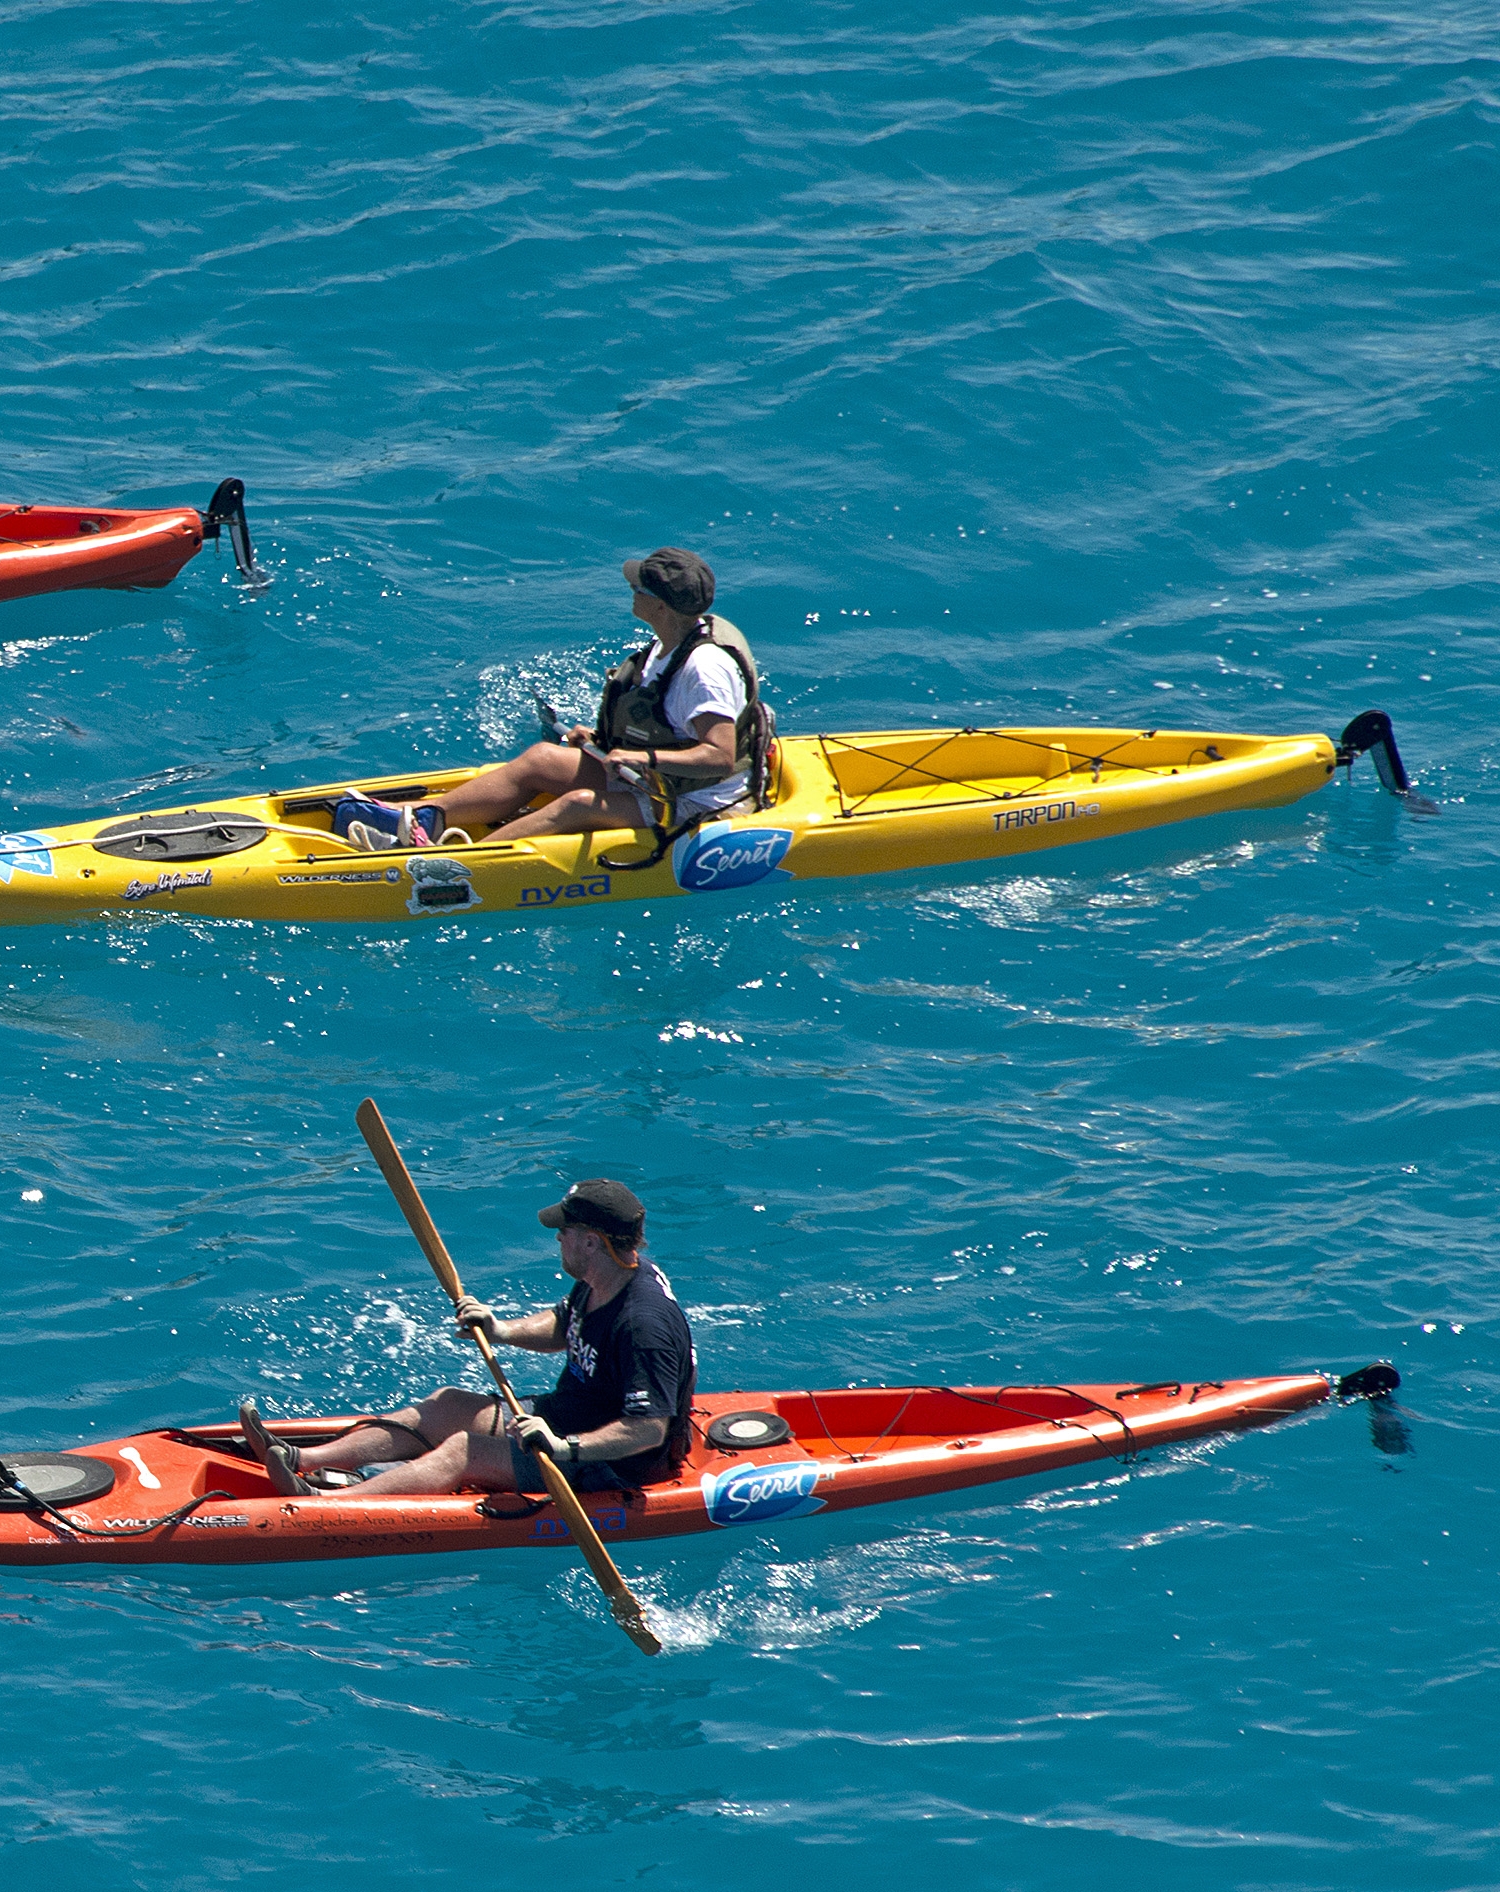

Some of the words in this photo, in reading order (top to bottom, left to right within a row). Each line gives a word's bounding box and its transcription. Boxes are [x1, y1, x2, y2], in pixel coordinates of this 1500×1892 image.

[993, 801, 1075, 831] TARPON
[696, 833, 786, 886] Secret
[279, 871, 382, 884] WILDERNESS
[515, 875, 611, 907] nyad
[728, 1464, 818, 1519] Secret
[102, 1514, 250, 1528] WILDRNESS
[280, 1515, 358, 1531] Everglades
[362, 1515, 396, 1527] Area
[401, 1513, 470, 1526] Tours.com
